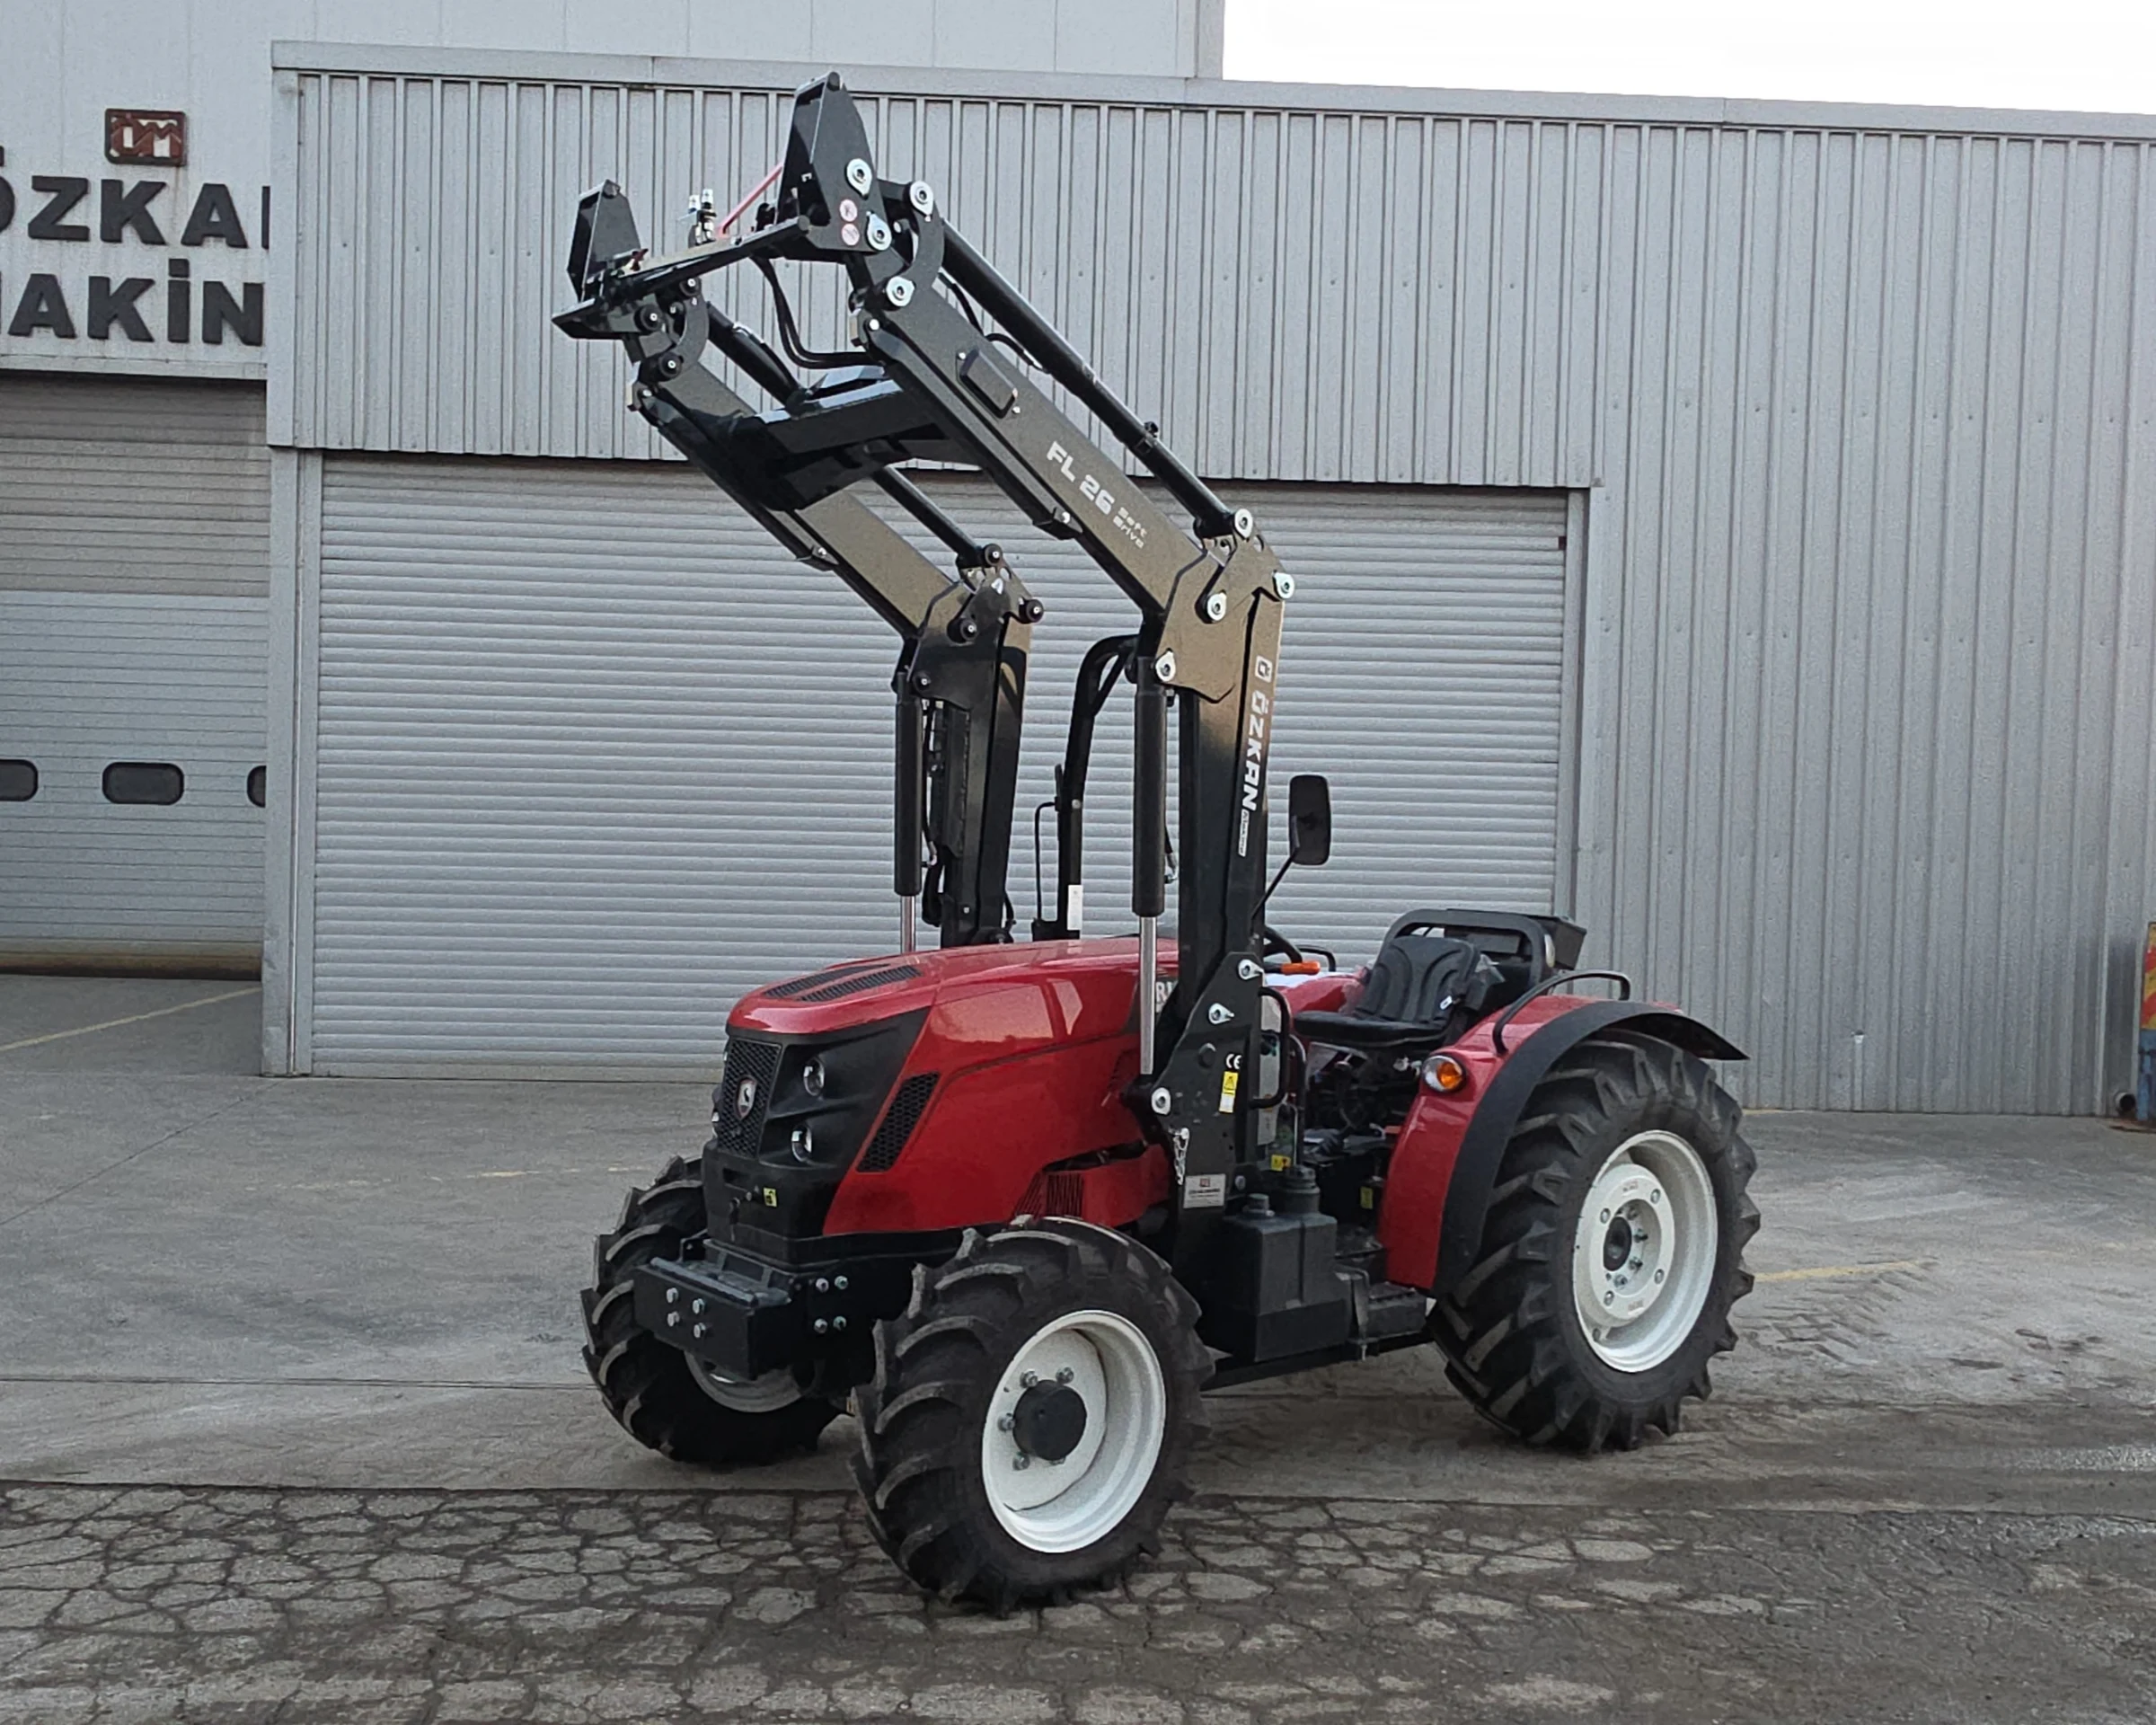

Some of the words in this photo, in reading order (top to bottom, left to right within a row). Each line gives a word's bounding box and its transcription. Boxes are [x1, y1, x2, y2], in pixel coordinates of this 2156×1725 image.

[0, 146, 270, 250] ZKA
[0, 258, 265, 347] AKİN
[1047, 441, 1076, 482] FL
[1079, 474, 1115, 515] 26
[1242, 690, 1269, 811] ÖZKAN
[1225, 1053, 1242, 1069] CE
